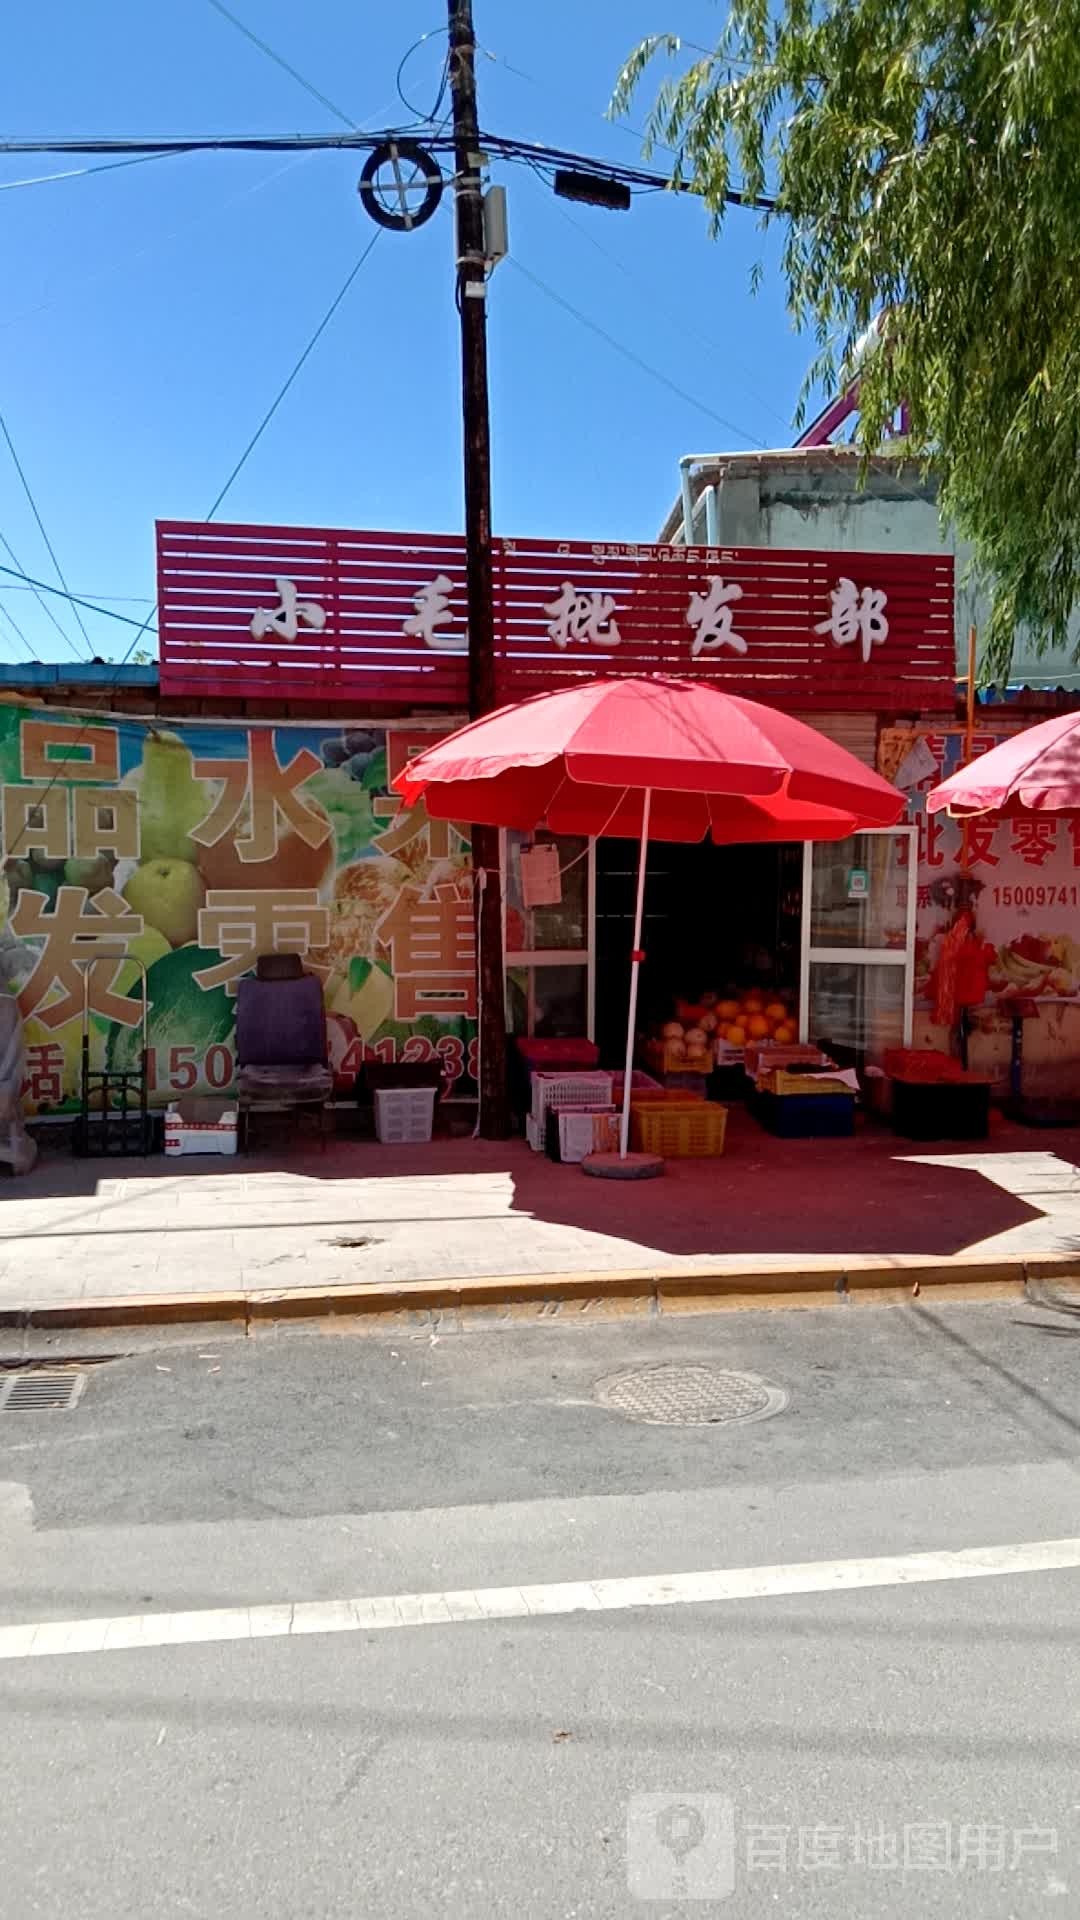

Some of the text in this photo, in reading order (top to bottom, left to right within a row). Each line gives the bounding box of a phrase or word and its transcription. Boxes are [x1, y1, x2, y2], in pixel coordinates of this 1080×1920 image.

[250, 574, 890, 663] 小毛批发部
[895, 811, 1080, 868] 批发零
